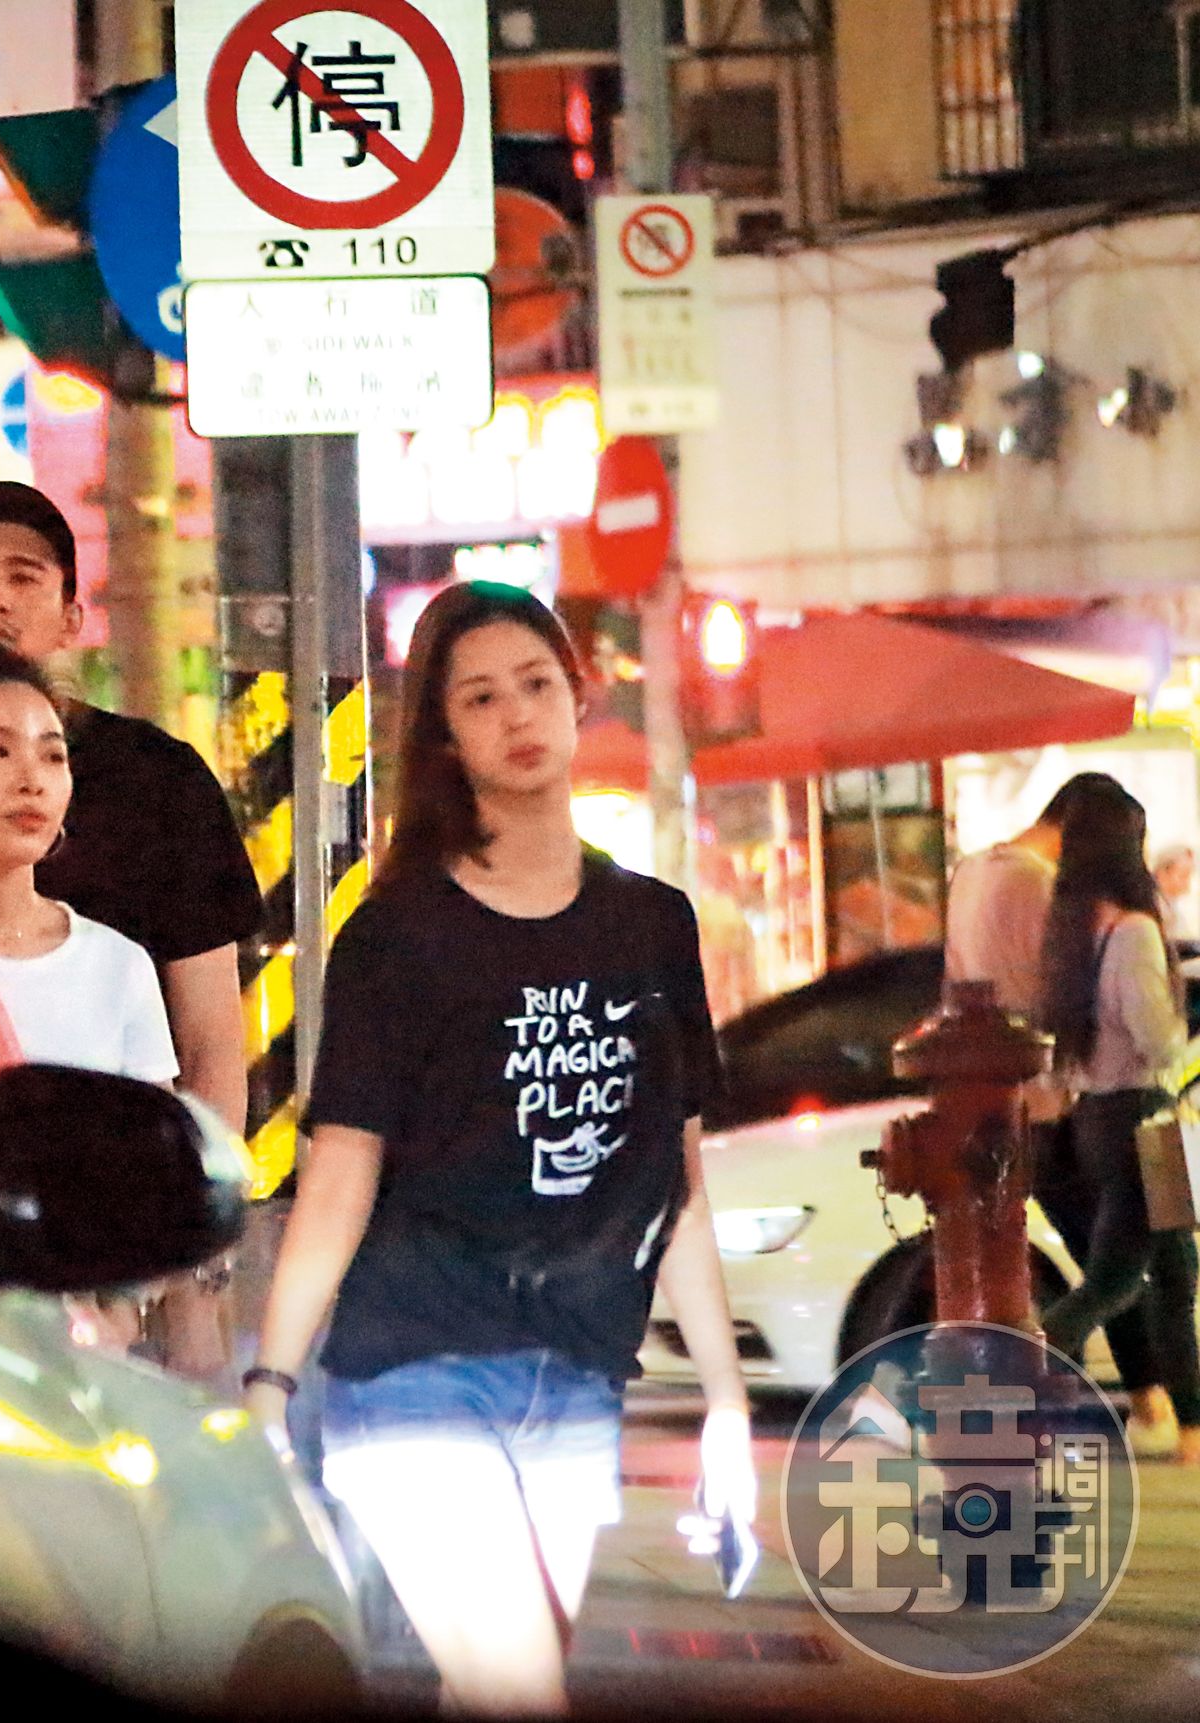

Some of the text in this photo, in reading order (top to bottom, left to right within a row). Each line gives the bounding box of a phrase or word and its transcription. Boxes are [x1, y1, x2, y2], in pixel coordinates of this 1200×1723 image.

[271, 41, 401, 168] 停
[343, 237, 418, 266] 110
[521, 981, 588, 1016] RUN
[504, 1013, 594, 1046] TO A
